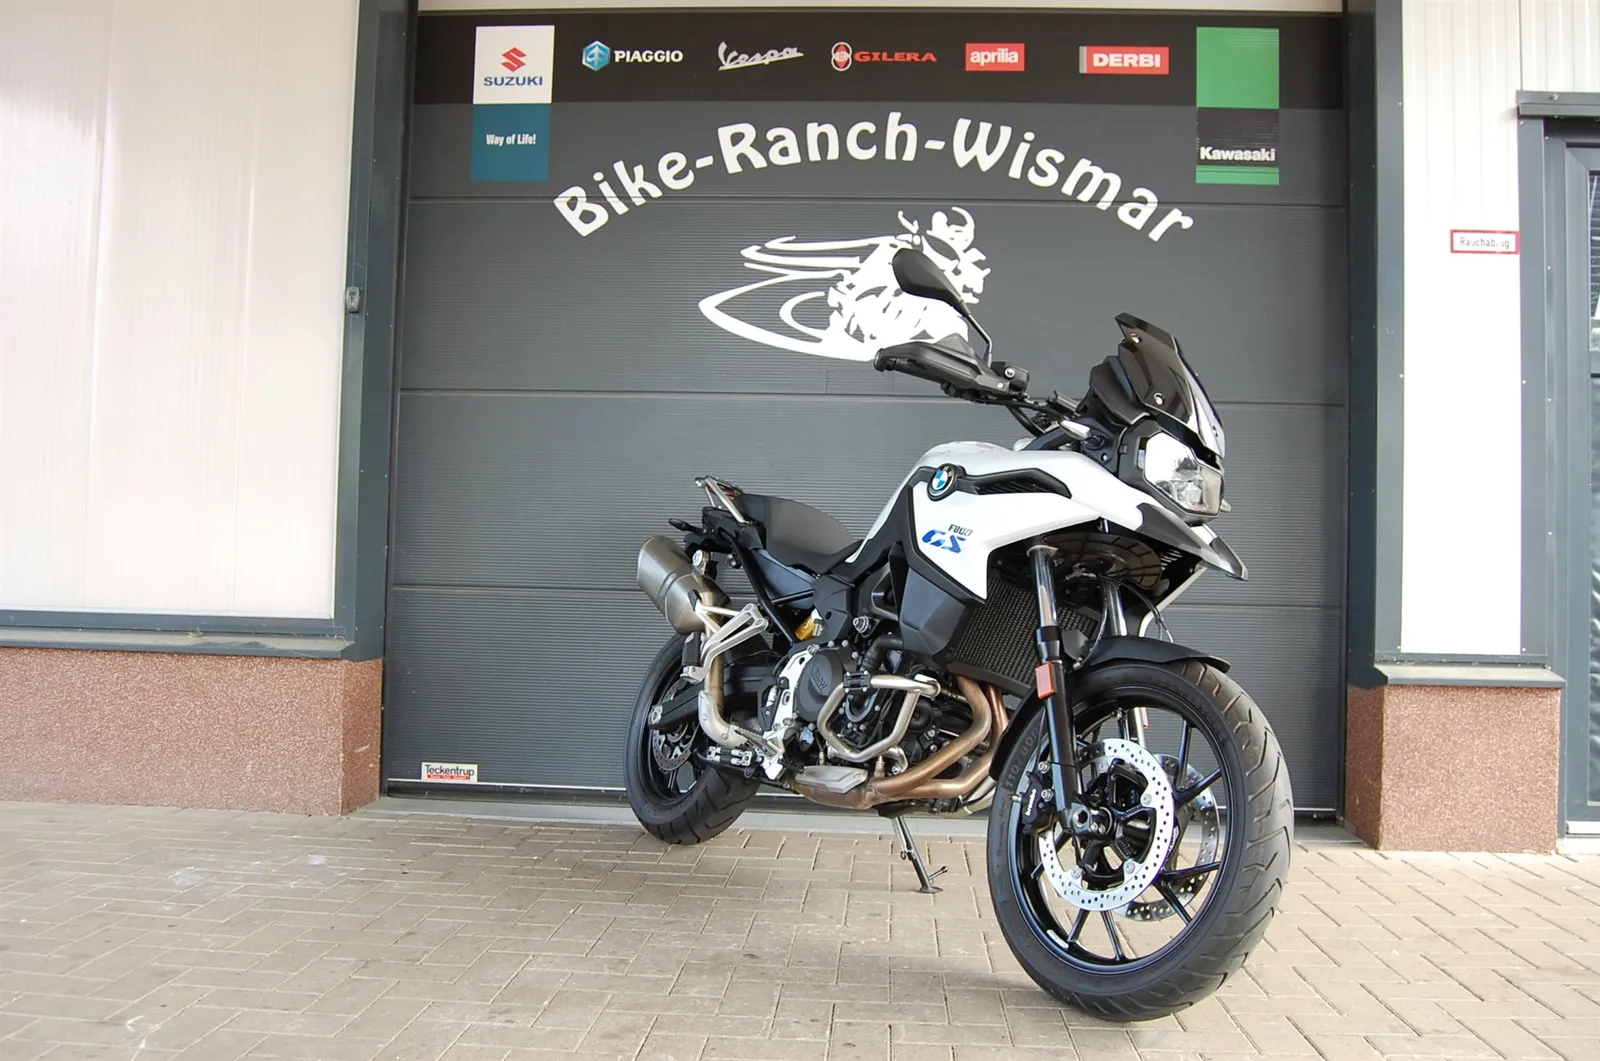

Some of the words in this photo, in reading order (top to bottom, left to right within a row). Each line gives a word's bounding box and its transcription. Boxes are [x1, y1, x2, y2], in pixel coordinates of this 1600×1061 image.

[613, 50, 684, 63] PIAGGIO
[718, 41, 804, 71] Vespa
[854, 51, 938, 63] GILERA
[970, 48, 1019, 66] aprilia
[1093, 53, 1161, 68] DERBI
[483, 76, 543, 86] SUZUKI
[486, 134, 504, 146] Way
[506, 134, 516, 145] of
[517, 134, 537, 145] Life!
[1200, 146, 1276, 161] Kawasaki
[553, 111, 1194, 242] Bike-Ranch-Wismar
[948, 524, 973, 537] F800
[922, 529, 966, 554] GS
[425, 765, 475, 776] Teckentrup
